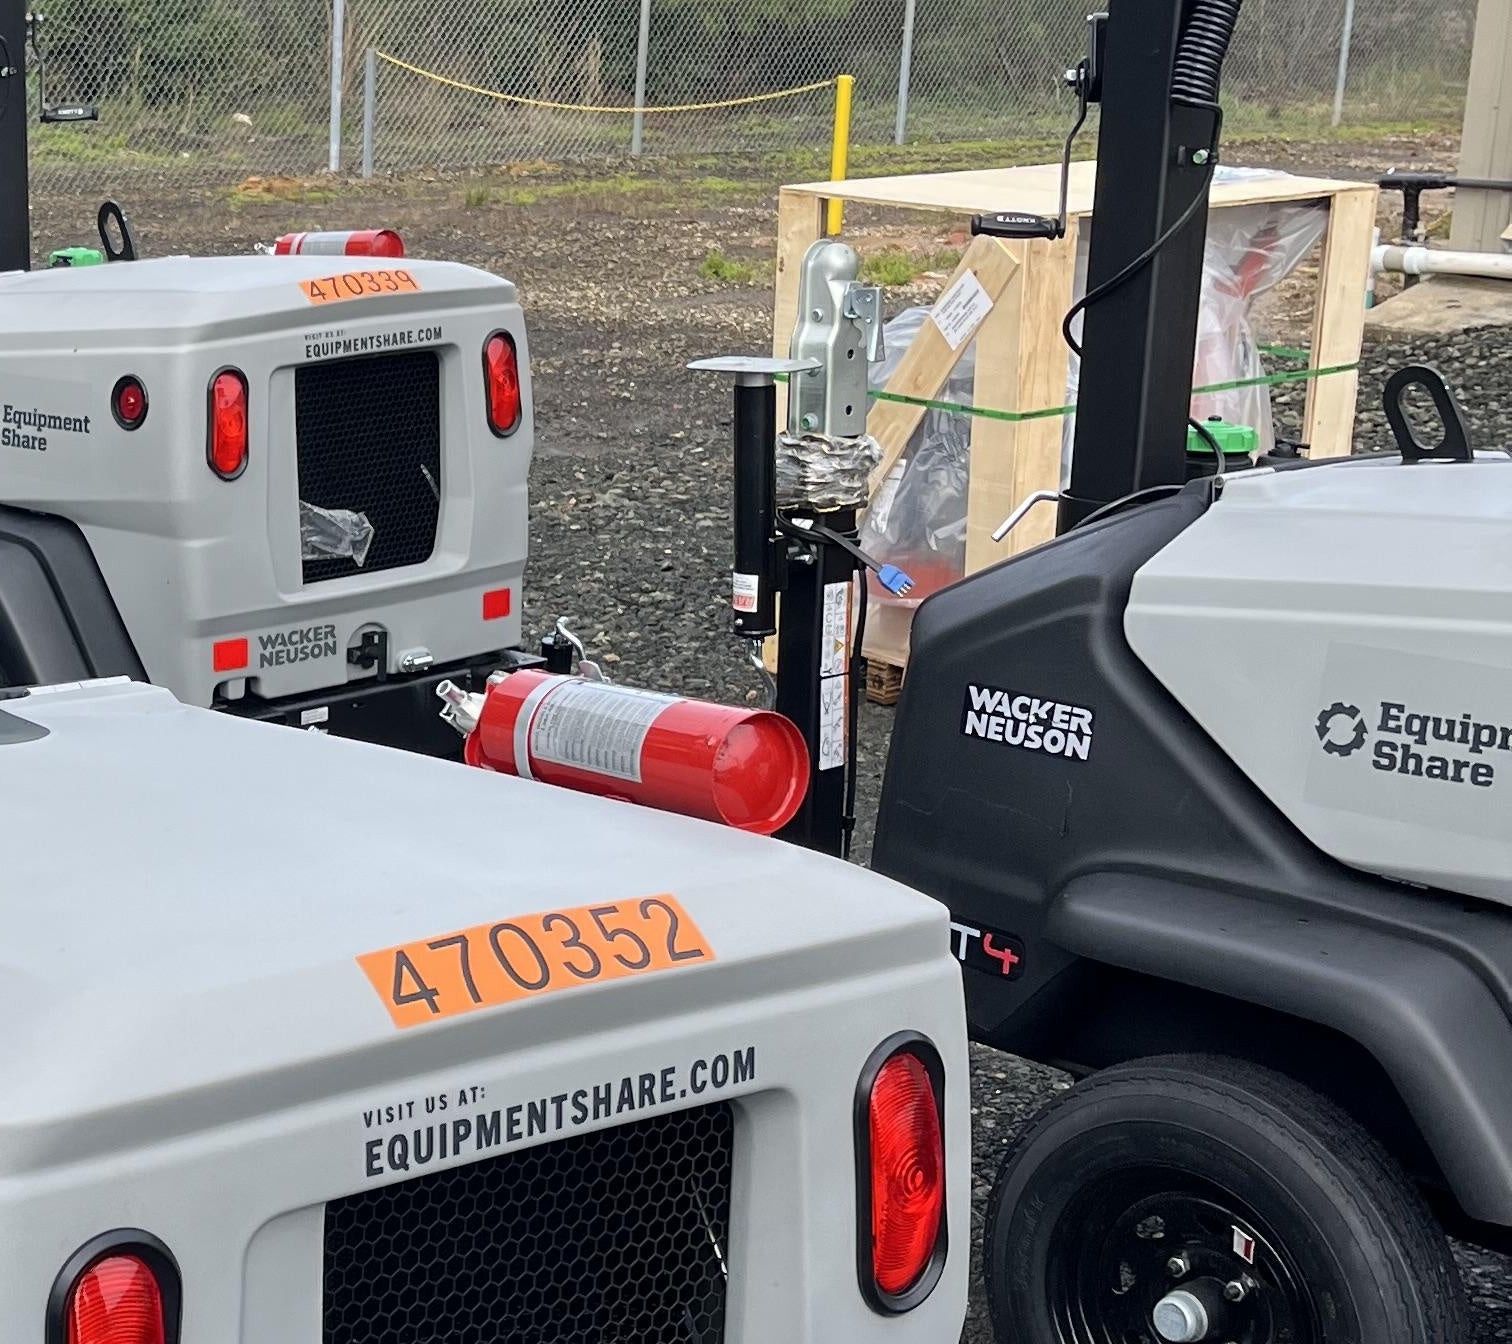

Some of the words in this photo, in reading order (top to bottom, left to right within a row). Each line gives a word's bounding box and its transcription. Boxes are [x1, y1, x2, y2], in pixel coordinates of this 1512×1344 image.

[310, 270, 418, 300] 470339
[306, 326, 442, 358] EQUIPMENTSHARE.COM
[3, 404, 90, 434] Equipment
[1, 428, 47, 451] Share
[258, 624, 336, 651] WACKER
[260, 640, 337, 668] NEUSON
[969, 685, 1093, 735] WACKER
[964, 710, 1091, 760] NEUSON
[1372, 740, 1494, 787] Share
[393, 900, 703, 1014] 470352
[363, 1101, 414, 1128] VISIT
[426, 1096, 448, 1114] US
[458, 1086, 486, 1106] AT:
[365, 1047, 755, 1177] EQUIPMENTSHARE.COM
